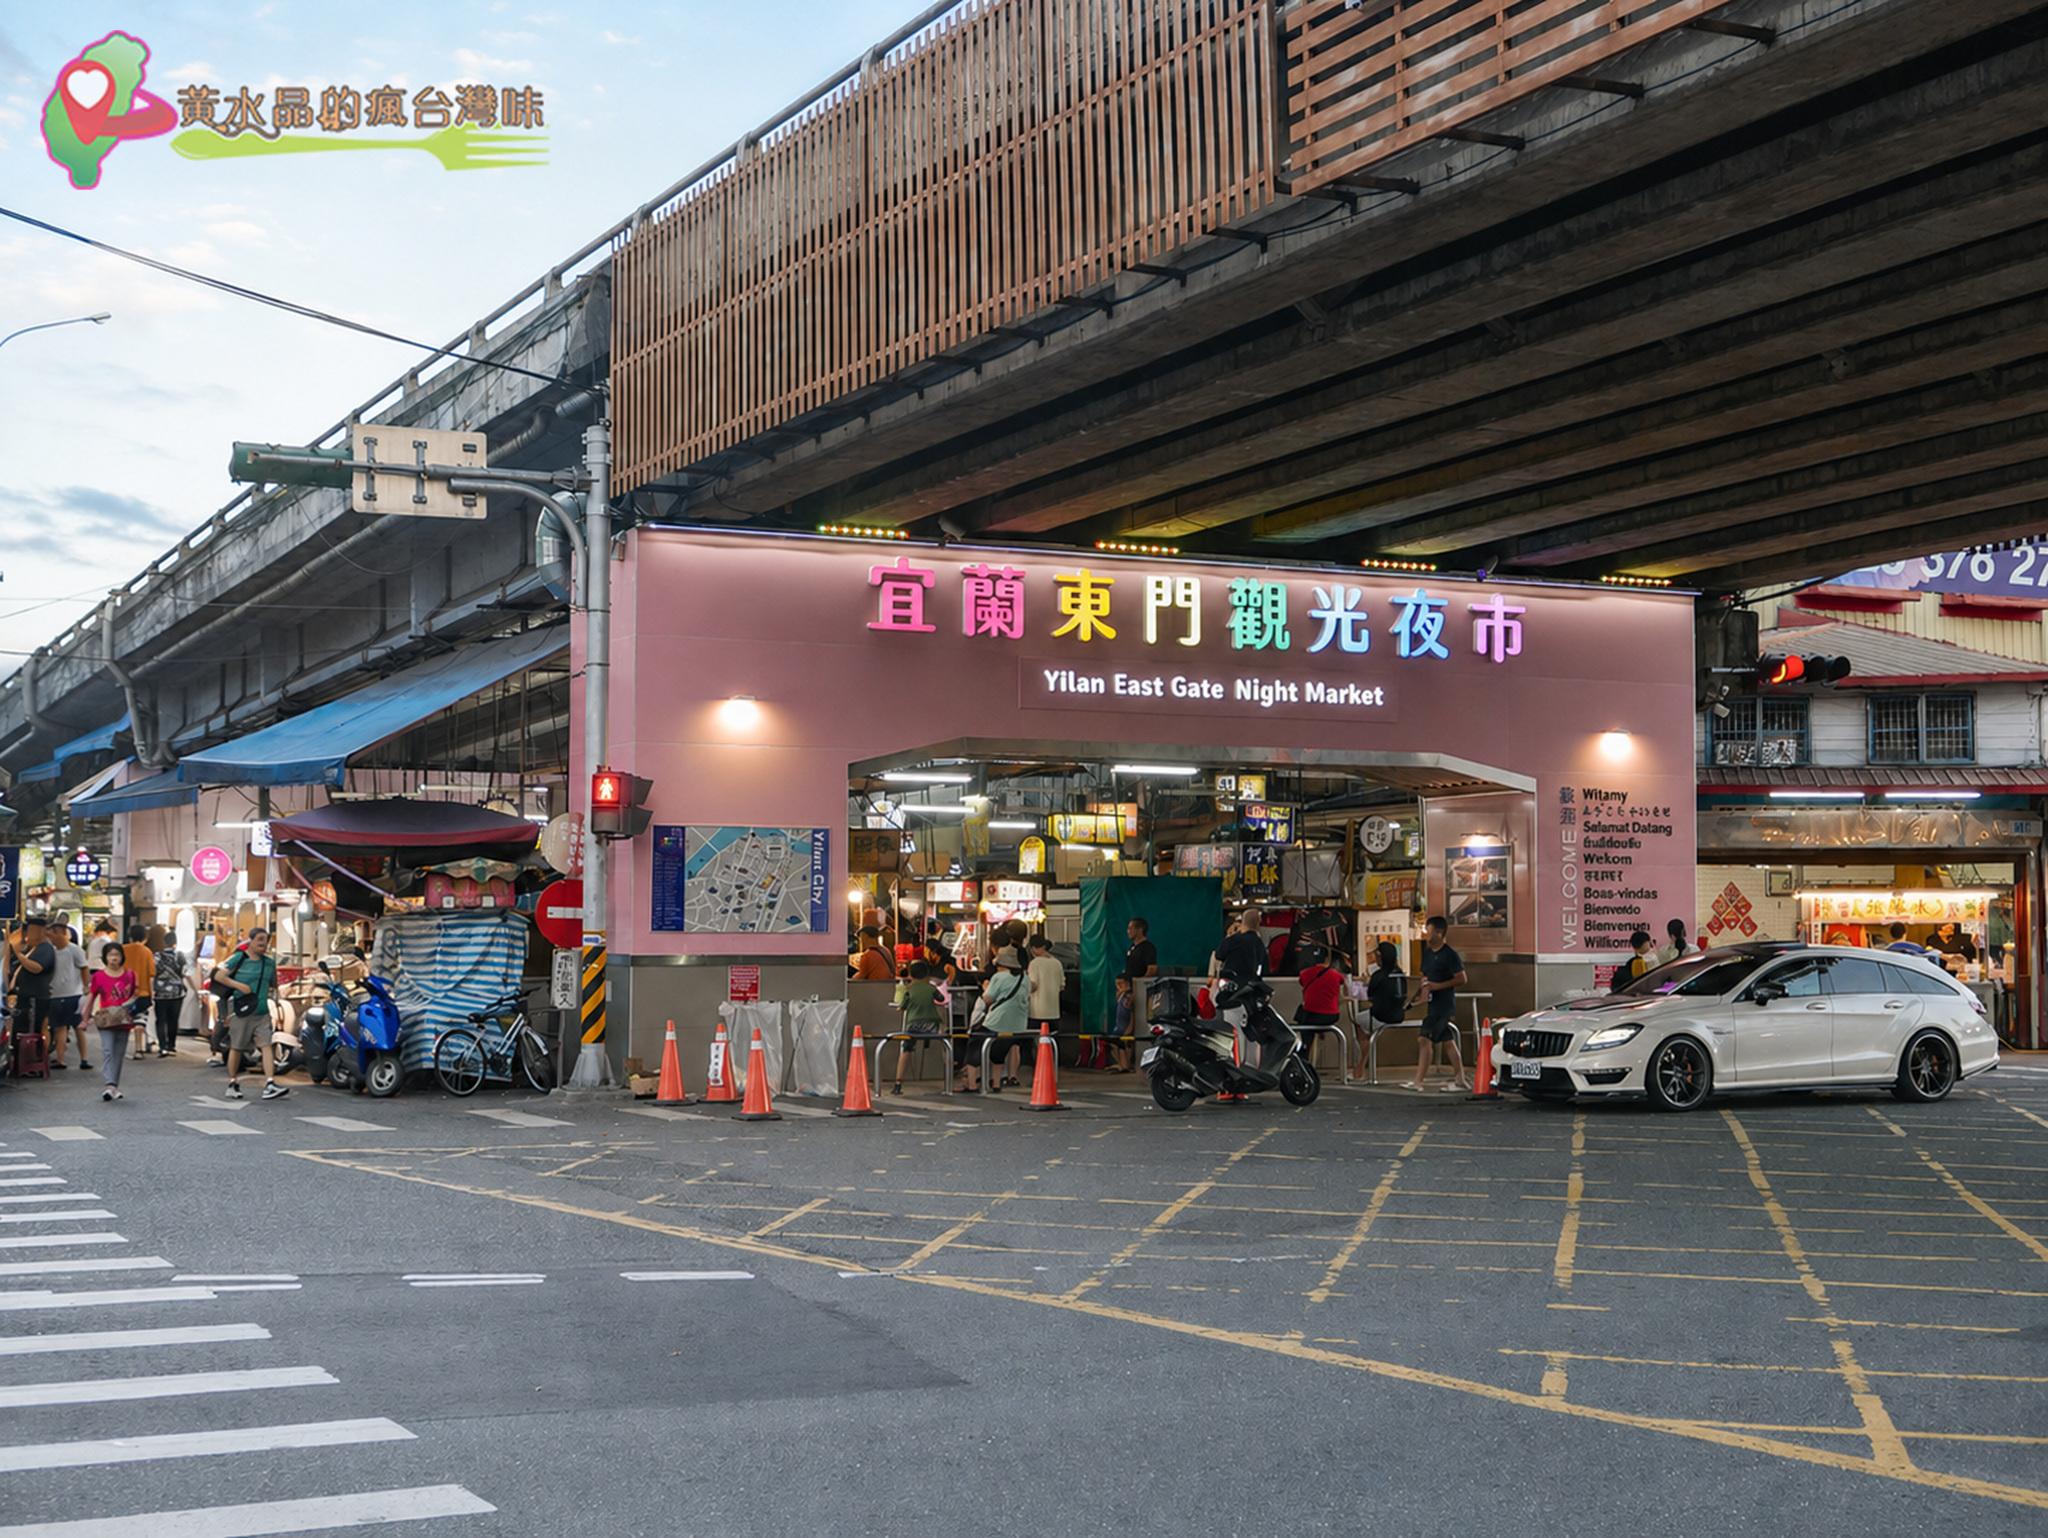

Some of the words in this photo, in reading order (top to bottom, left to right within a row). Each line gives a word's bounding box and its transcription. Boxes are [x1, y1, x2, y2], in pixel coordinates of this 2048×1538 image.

[867, 556, 1527, 664] 宜蘭東門觀光夜市
[1043, 669, 1105, 695] Yilan
[1114, 672, 1164, 697] East
[1170, 675, 1224, 699] Gate
[1235, 677, 1298, 706] Night
[1305, 680, 1384, 706] Market
[1582, 788, 1628, 804] Witamy
[1583, 821, 1629, 833] Selamat
[1632, 822, 1672, 836] Datang
[812, 875, 825, 905] City
[1562, 830, 1577, 949] WELCOME
[1583, 887, 1658, 899] Boas-vindas
